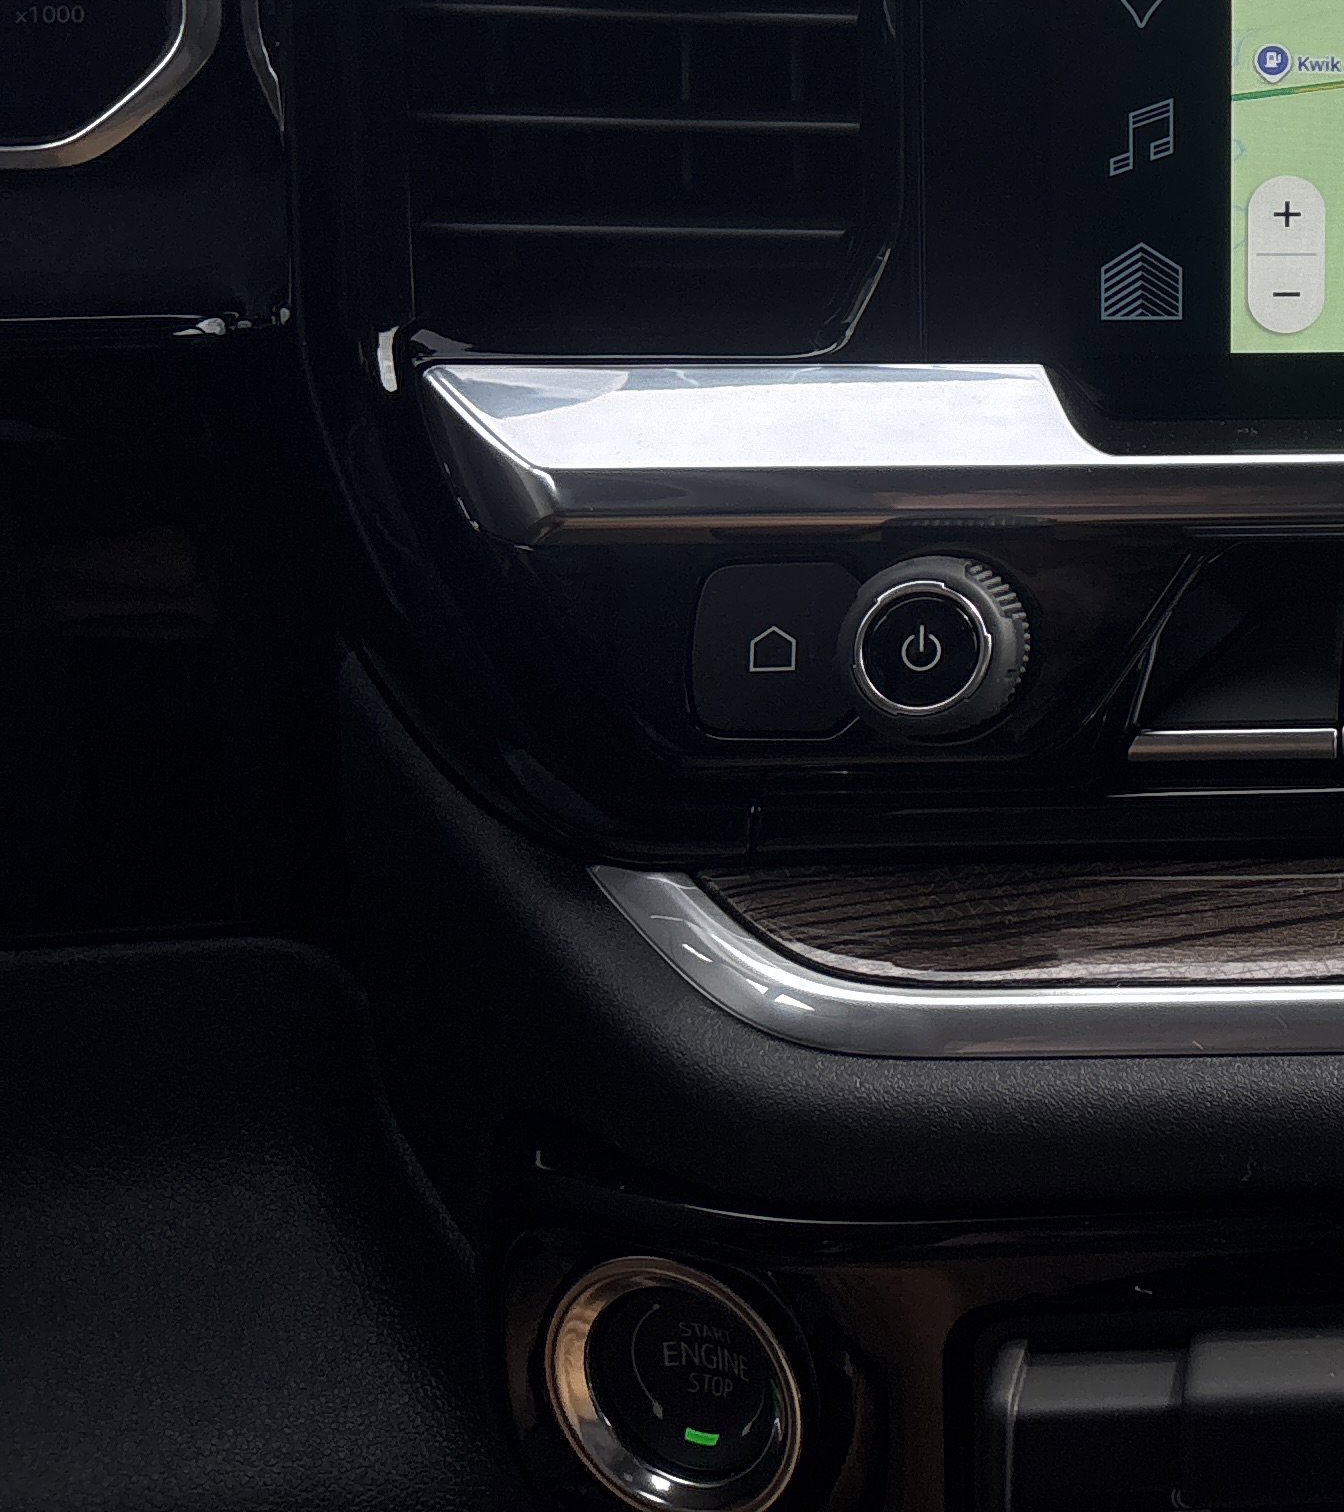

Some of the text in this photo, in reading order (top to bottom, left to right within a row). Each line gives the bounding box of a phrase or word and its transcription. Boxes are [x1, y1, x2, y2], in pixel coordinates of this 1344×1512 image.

[1297, 56, 1342, 73] Kwik
[661, 1341, 750, 1381] ENGINE
[687, 1372, 733, 1399] STOP
